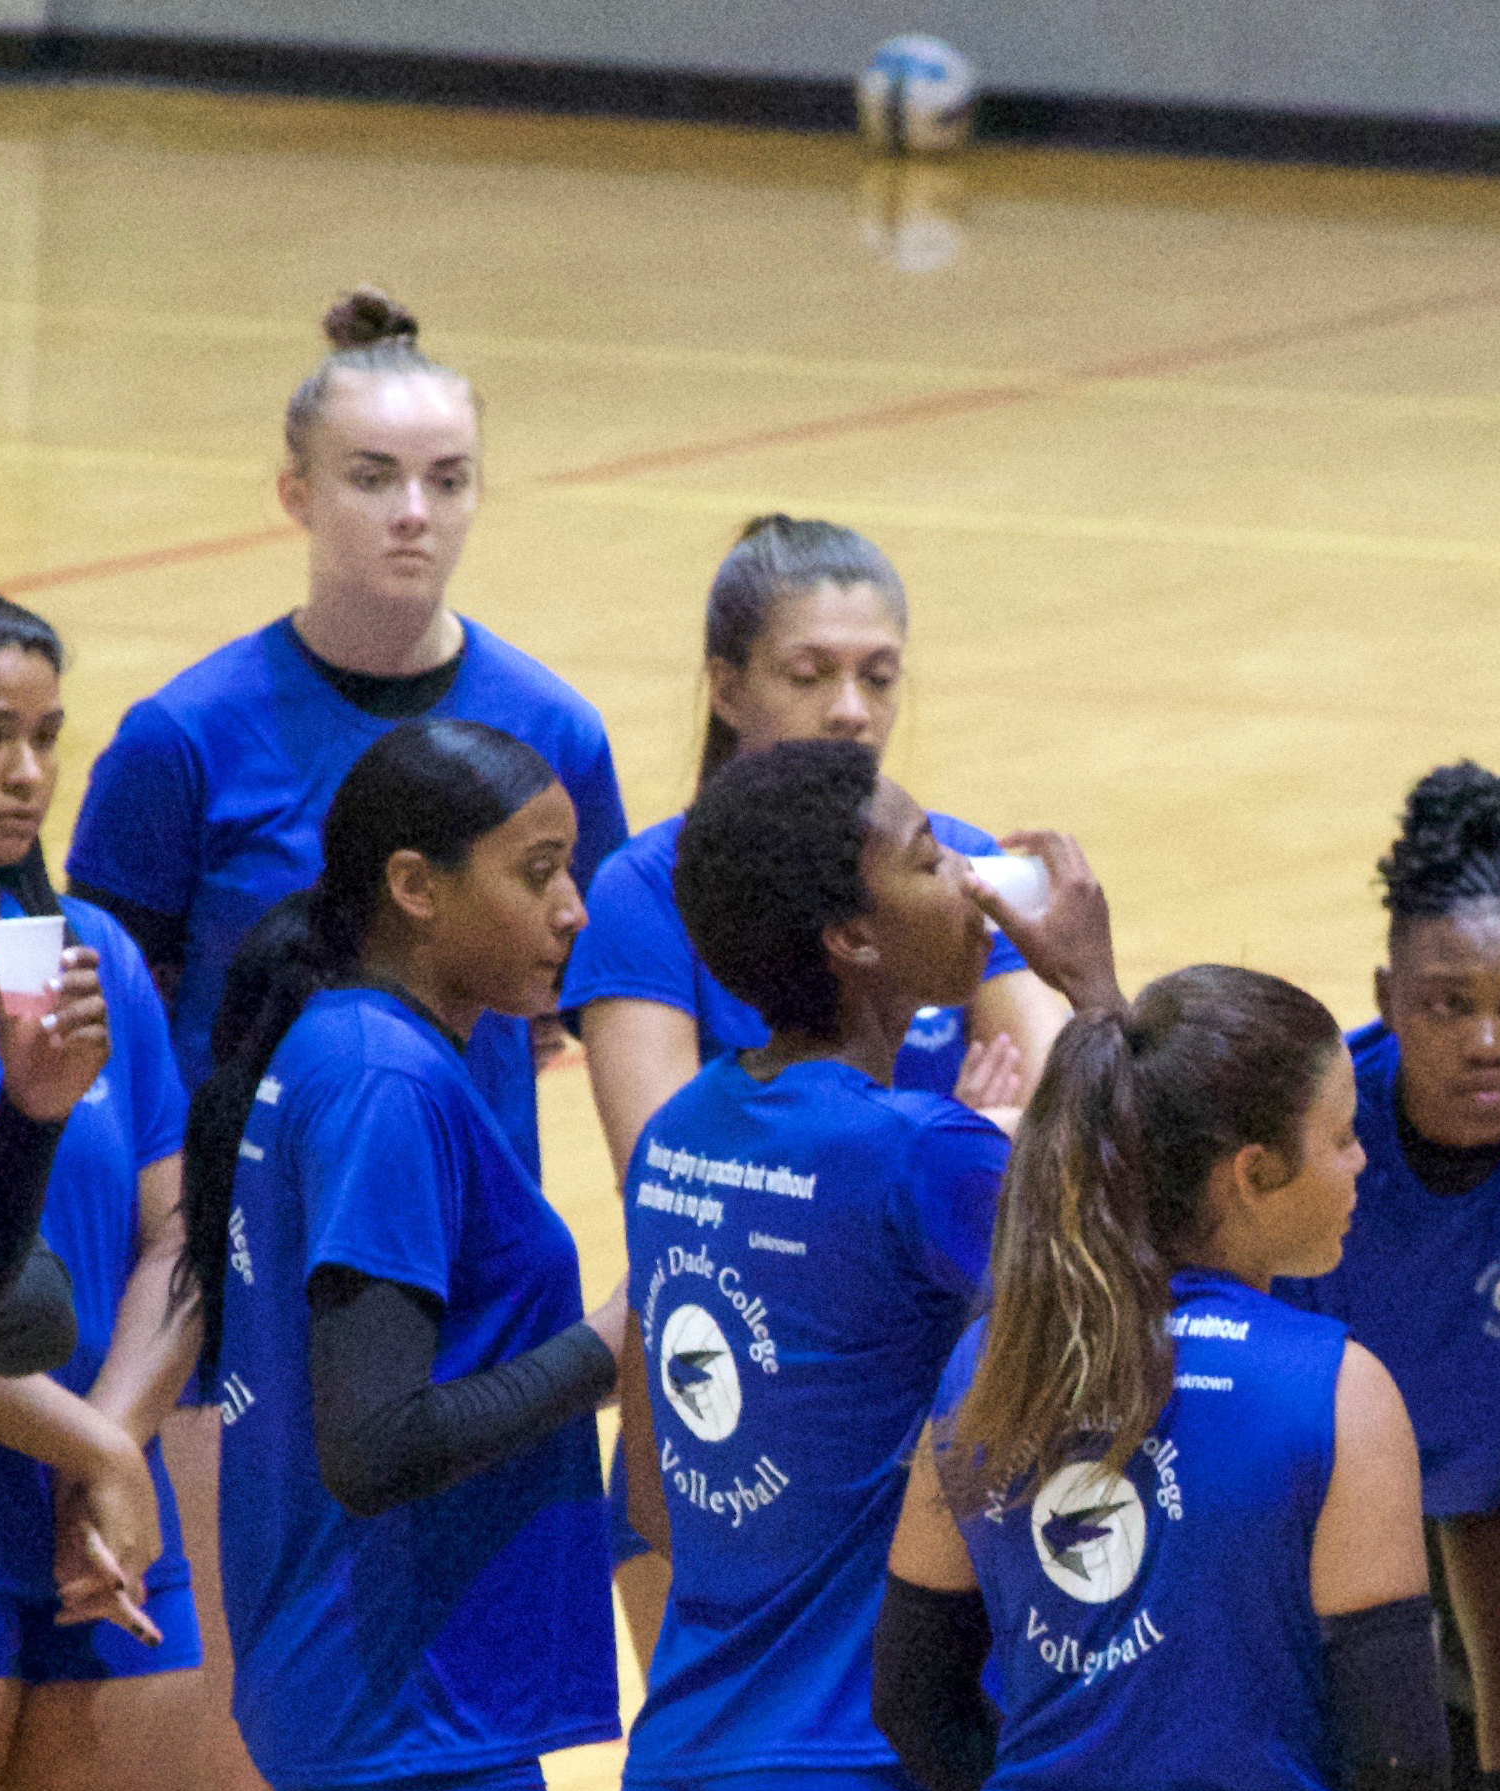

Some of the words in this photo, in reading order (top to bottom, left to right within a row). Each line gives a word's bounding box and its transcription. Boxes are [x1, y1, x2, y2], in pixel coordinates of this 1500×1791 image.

[765, 1165, 817, 1200] without
[228, 1205, 255, 1286] llege
[667, 1242, 715, 1280] Dade
[718, 1266, 780, 1375] College
[1188, 1314, 1250, 1341] without
[1174, 1372, 1234, 1392] nknown
[660, 1436, 790, 1529] Volleyball
[1142, 1435, 1184, 1522] ollege
[1026, 1605, 1166, 1687] Volleyball
